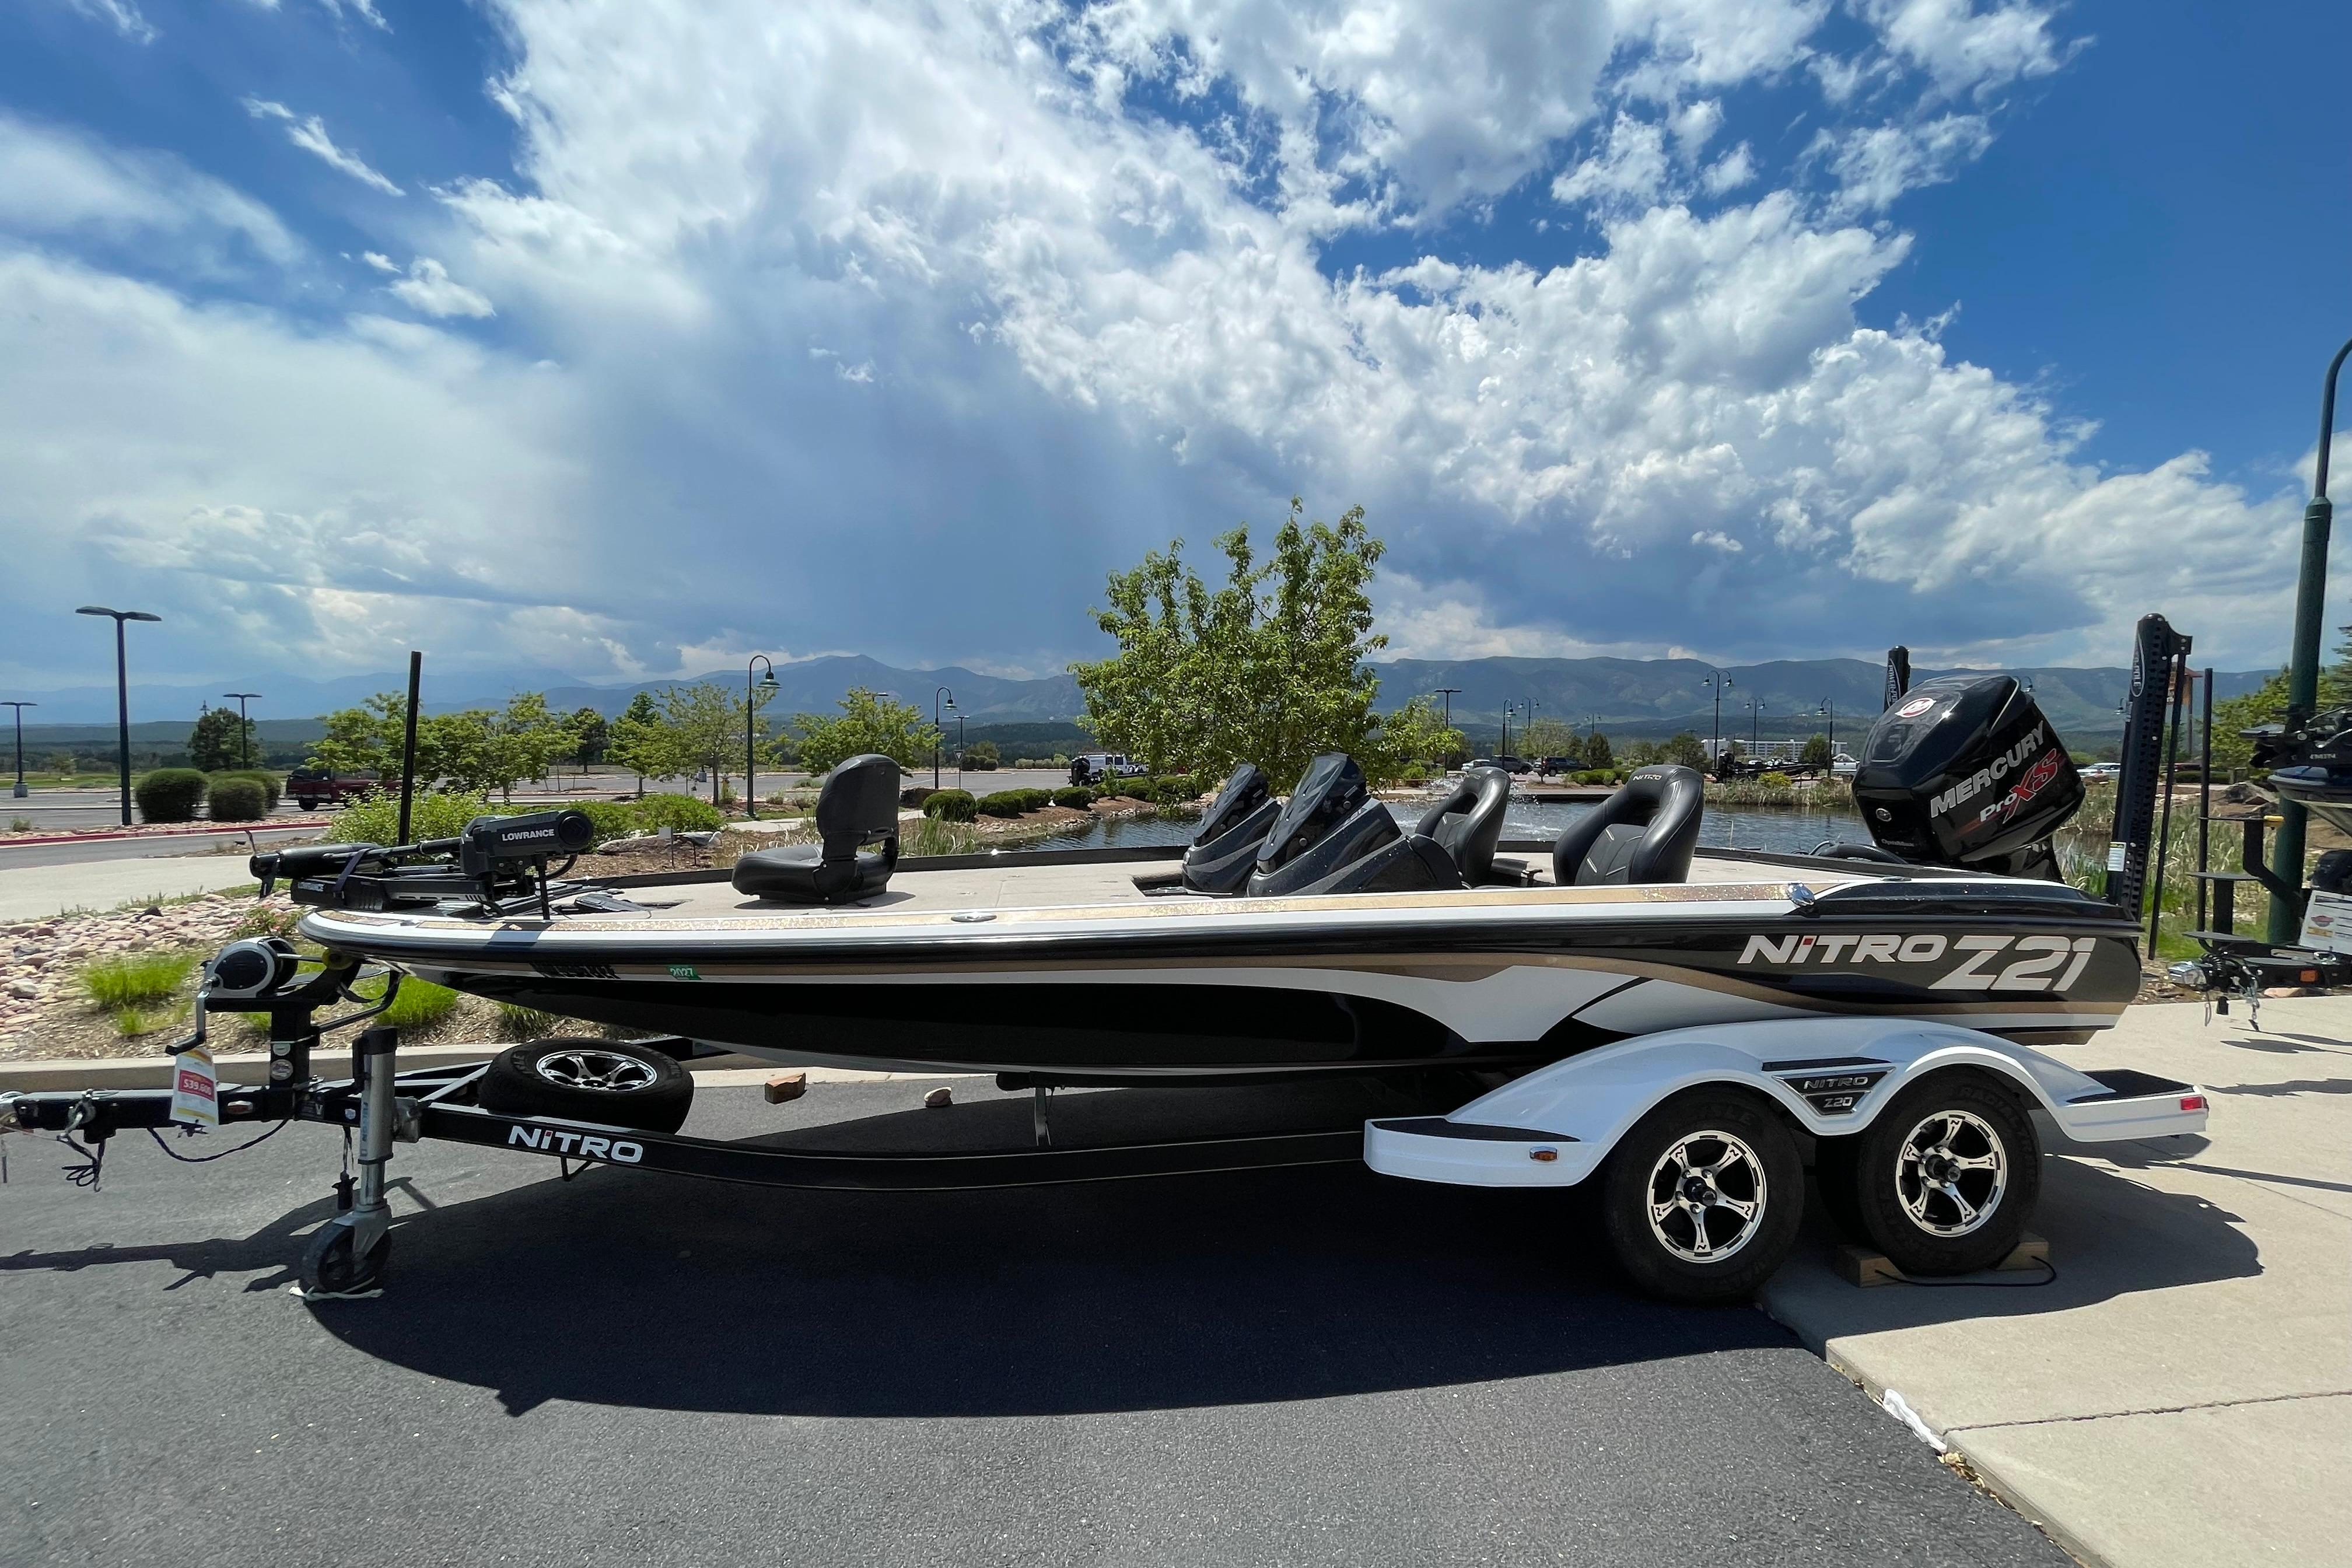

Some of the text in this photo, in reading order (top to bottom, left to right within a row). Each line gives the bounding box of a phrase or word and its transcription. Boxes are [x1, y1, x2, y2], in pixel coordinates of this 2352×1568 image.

[1931, 720, 2044, 818] MERCURY
[502, 829, 555, 841] LOWRANCE
[1928, 936, 2096, 991] Z21
[670, 968, 694, 977] 2027
[1804, 1076, 1868, 1089] NITRO
[1824, 1097, 1859, 1108] Z20
